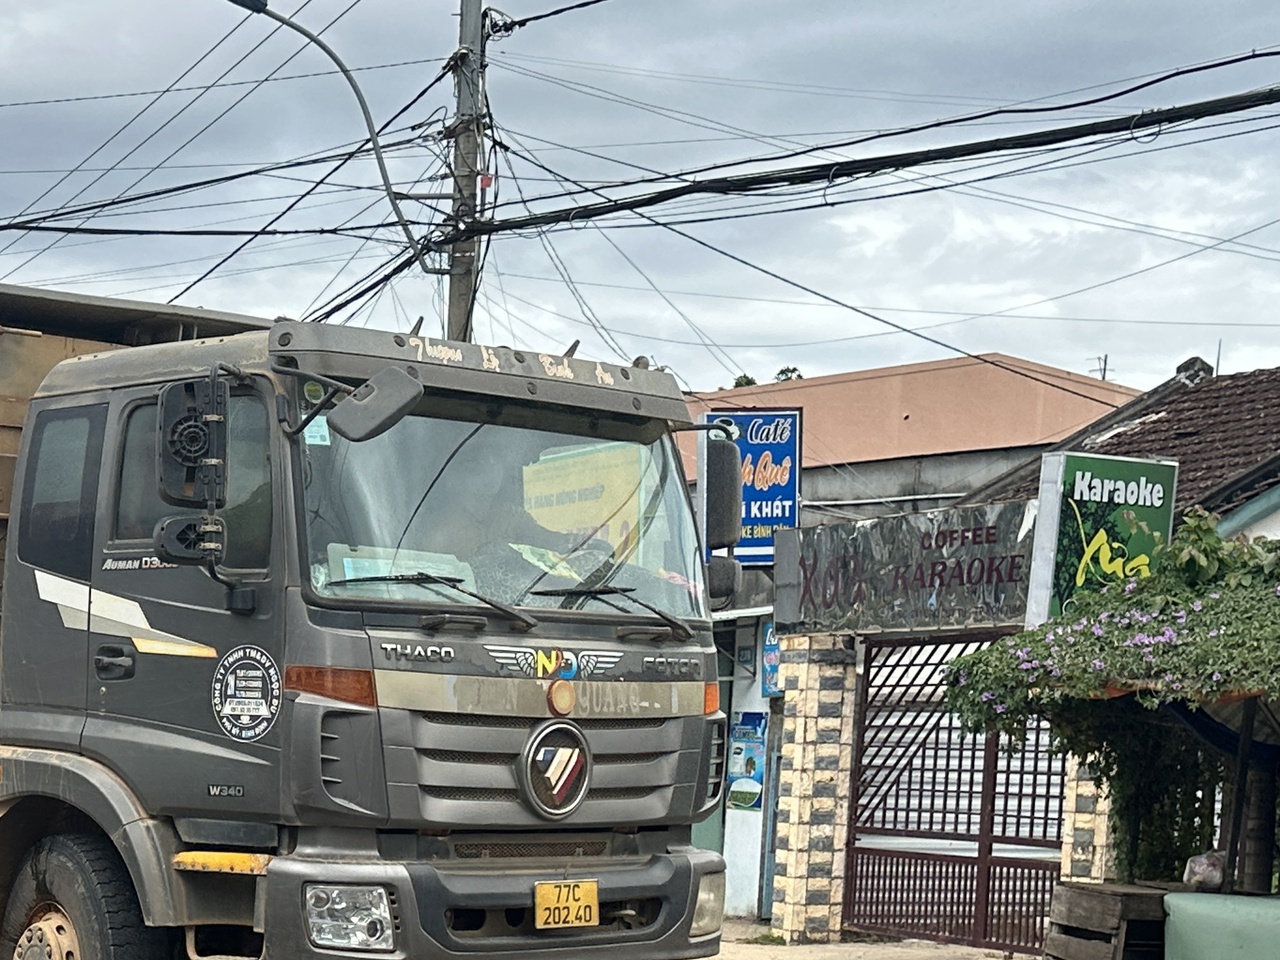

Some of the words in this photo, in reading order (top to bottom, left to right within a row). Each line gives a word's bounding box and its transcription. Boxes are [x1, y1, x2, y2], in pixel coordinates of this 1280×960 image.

[754, 451, 791, 491] Quê
[1073, 471, 1164, 508] Karaoke
[750, 495, 793, 518] KHÁT
[921, 526, 997, 549] COFFEE
[890, 554, 1025, 592] KARAOKE
[381, 643, 455, 664] THACO
[208, 786, 243, 797] W340
[554, 884, 581, 903] 77C
[543, 905, 592, 925] 202.40
